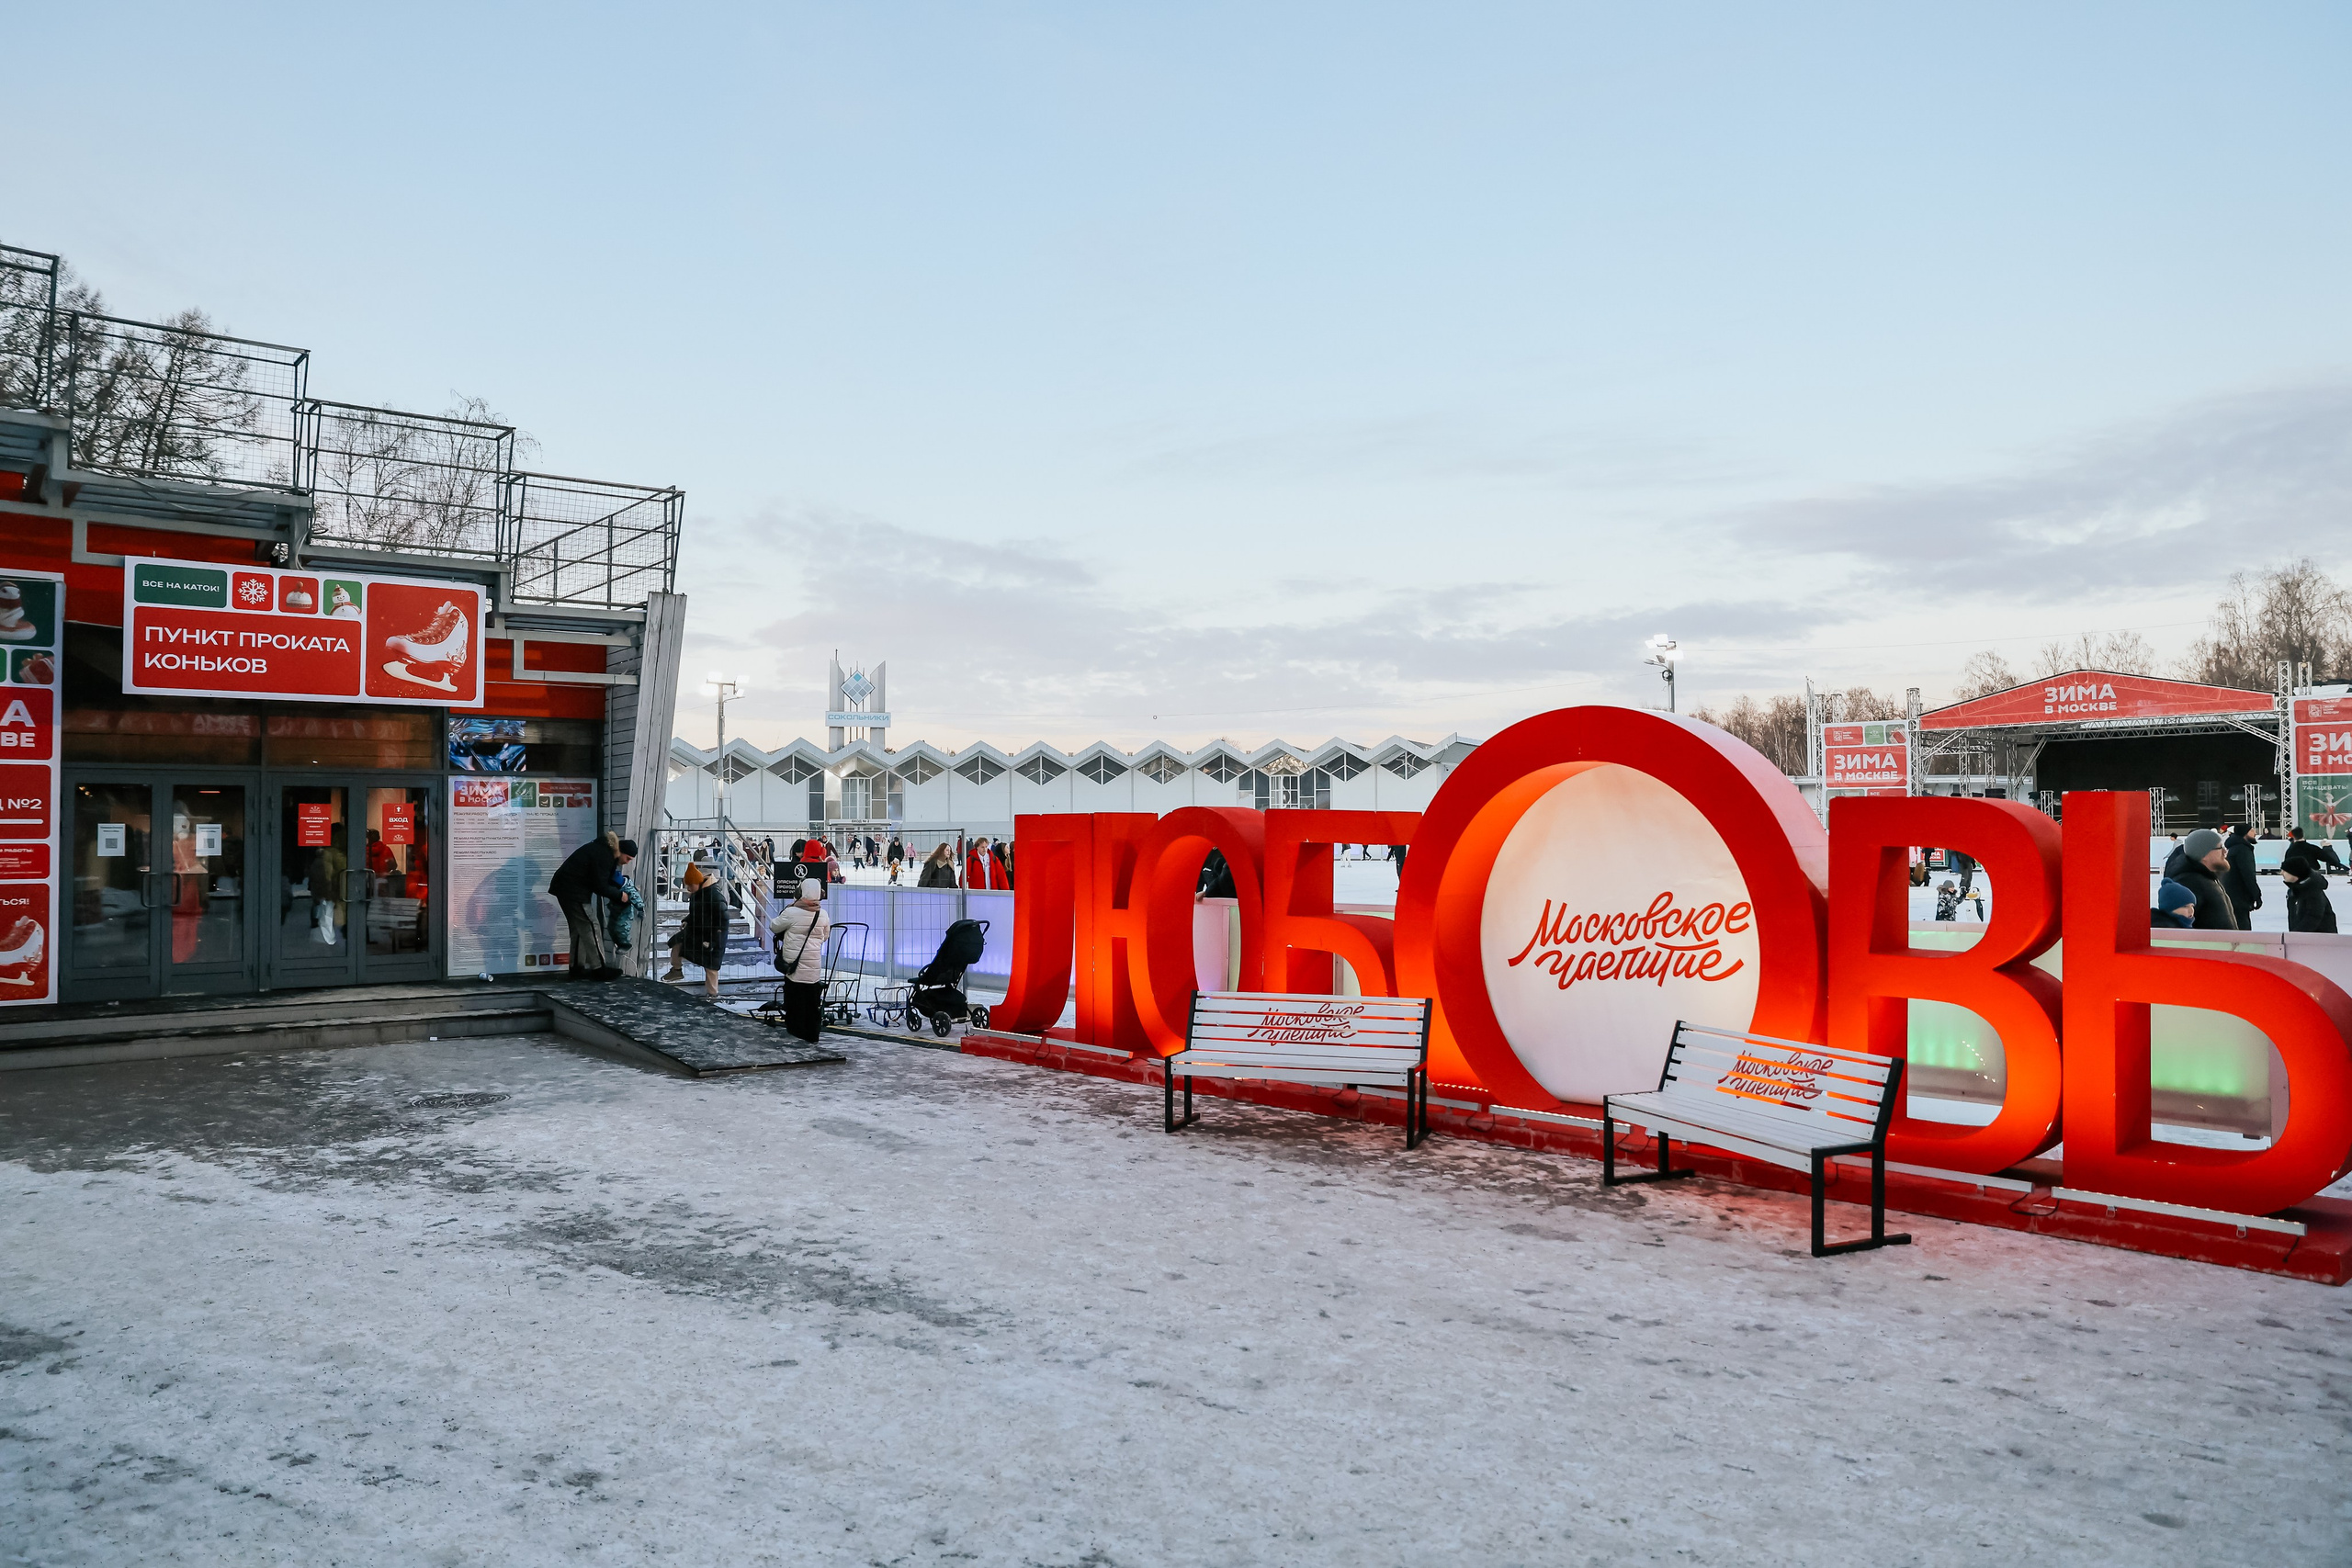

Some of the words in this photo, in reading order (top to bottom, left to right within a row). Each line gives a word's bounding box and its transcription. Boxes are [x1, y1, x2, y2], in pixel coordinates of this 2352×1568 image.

[142, 580, 164, 589] ВСЕ
[165, 581, 181, 590] НА
[183, 582, 220, 592] КАТОК!
[144, 626, 234, 646] ПУНКТ
[239, 631, 351, 653] ПРОКАТА
[144, 652, 268, 674] КОНЬКОВ
[2044, 683, 2117, 703] ЗИМА
[2044, 705, 2054, 714] В
[2058, 702, 2117, 714] МОСКВЕ
[1834, 753, 1897, 770] ЗИМА
[2309, 754, 2322, 766] В
[1834, 773, 1843, 781] В
[1846, 771, 1898, 781] МОСКВЕ
[459, 785, 503, 796] ЗИМА
[7, 798, 42, 809] №2
[1508, 891, 1752, 967] Московское
[989, 706, 2352, 1217] ЛЮБОВЬ
[1533, 938, 1745, 990] чаепитие
[1247, 1002, 1365, 1038] Московское
[1717, 1049, 1834, 1084] Московское
